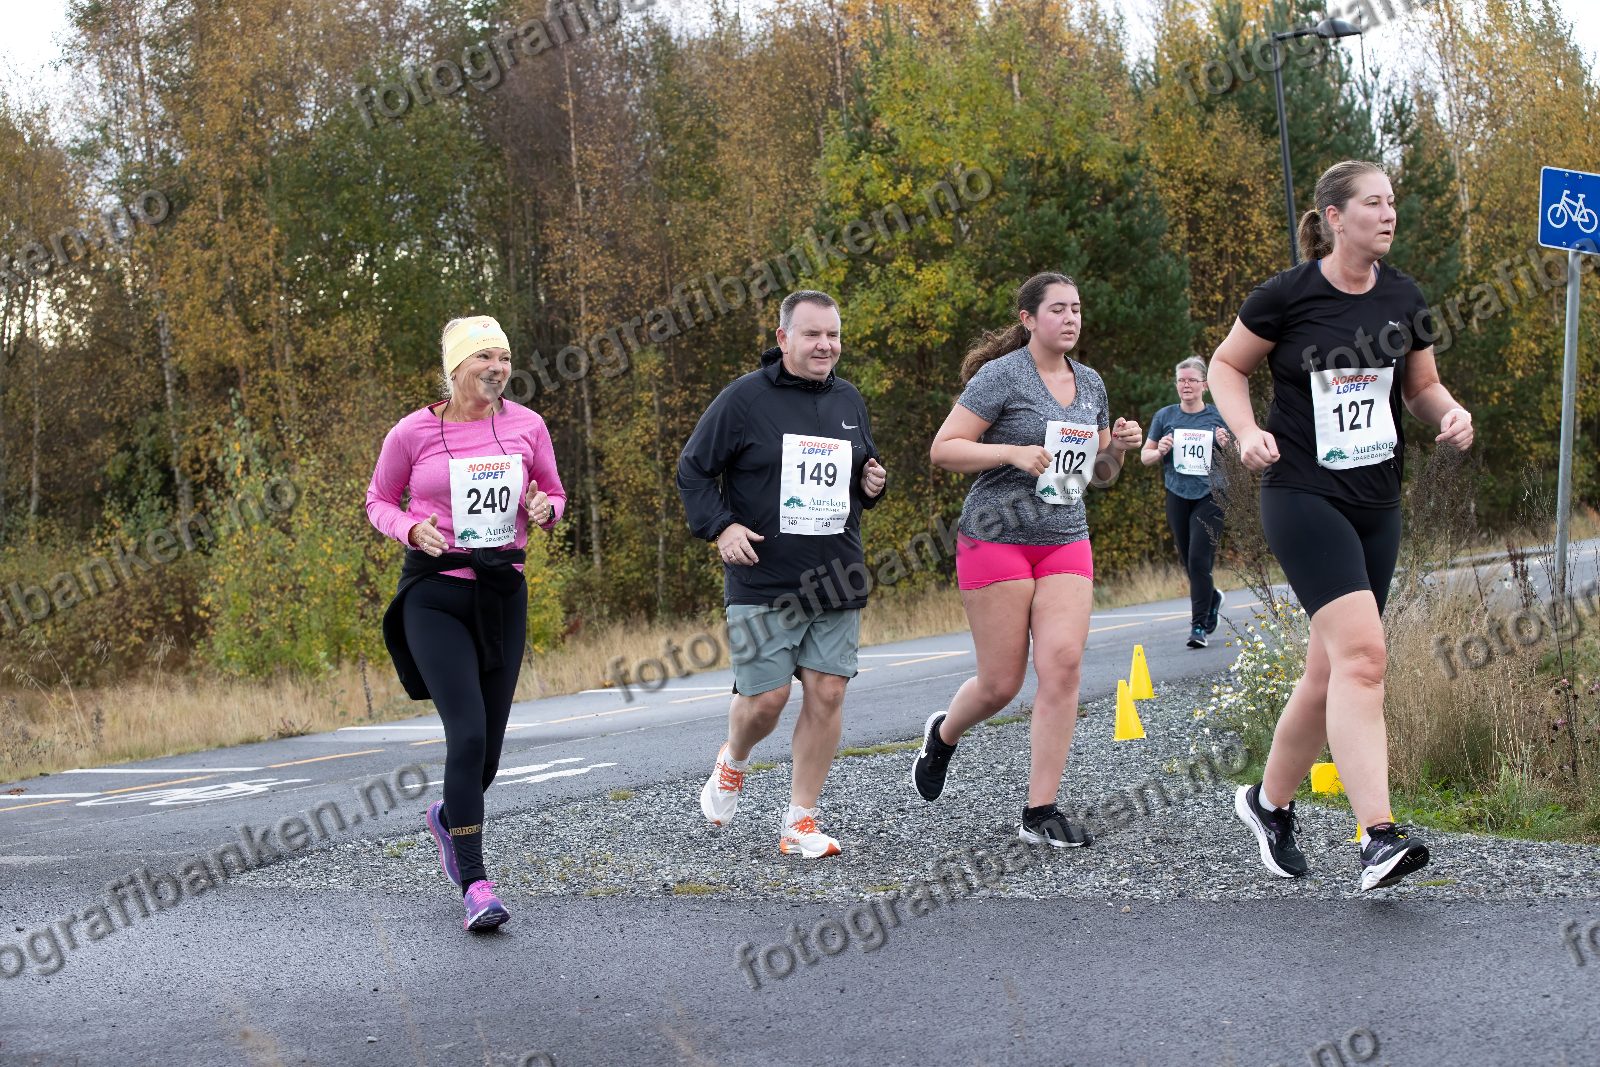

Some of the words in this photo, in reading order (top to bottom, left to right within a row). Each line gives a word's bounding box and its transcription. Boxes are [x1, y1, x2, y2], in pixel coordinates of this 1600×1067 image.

[1331, 374, 1378, 385] NORGES
[1336, 382, 1369, 395] LØPET
[1332, 398, 1375, 433] 127
[1060, 427, 1094, 439] NORGES
[799, 440, 840, 450] NORGES
[1060, 435, 1088, 445] LØPET
[801, 447, 833, 457] LØPET
[1181, 444, 1204, 459] 140
[1352, 440, 1395, 455] Aurskog
[467, 461, 511, 472] NORGES
[1054, 449, 1087, 475] 102
[472, 470, 506, 481] LØPET
[796, 460, 838, 488] 149
[466, 485, 511, 515] 240
[809, 496, 847, 510] Aurskog
